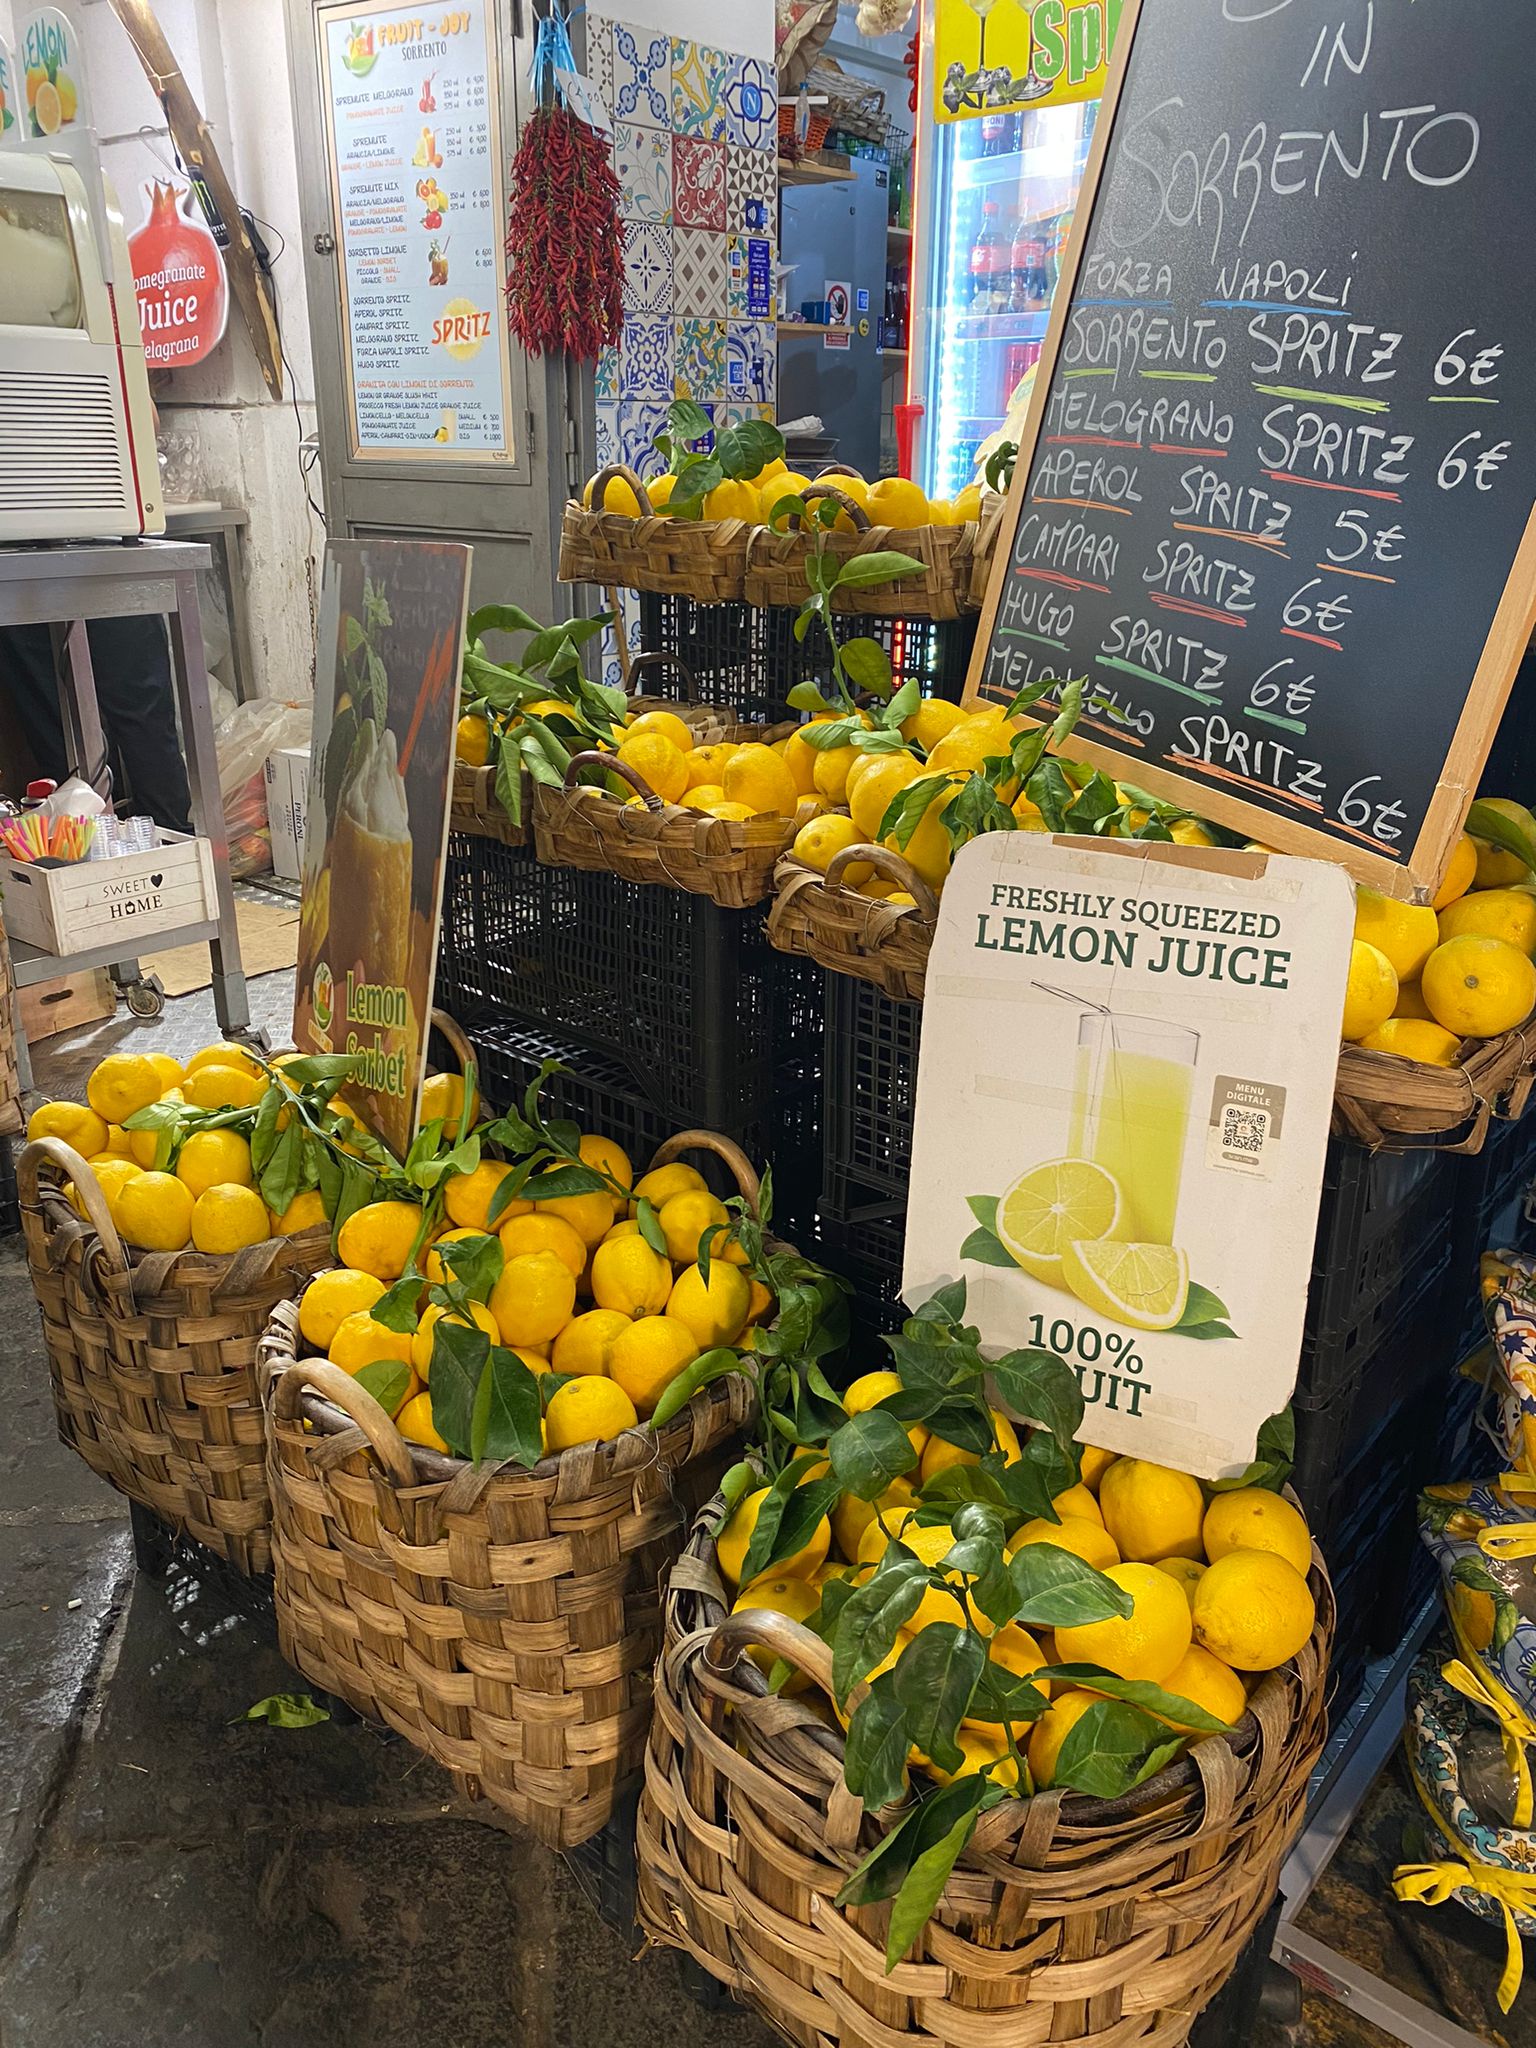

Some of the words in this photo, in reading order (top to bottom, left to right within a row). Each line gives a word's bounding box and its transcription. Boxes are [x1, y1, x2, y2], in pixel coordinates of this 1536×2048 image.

[22, 18, 68, 75] LEMON
[378, 19, 423, 47] FRUIT
[439, 10, 471, 36] JOY
[402, 41, 447, 60] SORRENTO
[1301, 1, 1373, 87] IN
[1110, 97, 1480, 265] SORRENTO
[135, 265, 206, 292] omegranate
[1080, 252, 1172, 297] FORZA
[139, 290, 198, 331] Juice
[145, 335, 199, 361] elagrana
[1064, 307, 1227, 391] SORRENTO
[1248, 313, 1403, 383] SPRITZ
[1047, 382, 1234, 445] MELOGRANO
[1257, 403, 1415, 483] SPRITZ
[1031, 448, 1142, 503] APEROL
[1170, 465, 1292, 540] SPRITZ
[1015, 513, 1120, 580] CAMPARI
[1142, 540, 1256, 611] SPRITZ
[1000, 580, 1074, 637] HUGO
[1101, 615, 1228, 690] SPRITZ
[1171, 714, 1327, 802] SPRITZ
[294, 801, 304, 839] PERONI
[103, 877, 148, 898] SWEET
[990, 883, 1115, 919] FRESHLY
[1120, 897, 1281, 939] SQUEEZED
[974, 913, 1138, 968] LEMON
[1147, 936, 1292, 990] JUICE
[347, 970, 408, 1031] Lemon
[345, 1031, 407, 1098] Sorbet
[1235, 1083, 1265, 1095] MENU
[1226, 1091, 1271, 1106] DIGITALE
[1028, 1314, 1143, 1374] 100%
[1074, 1364, 1151, 1417] UIT
